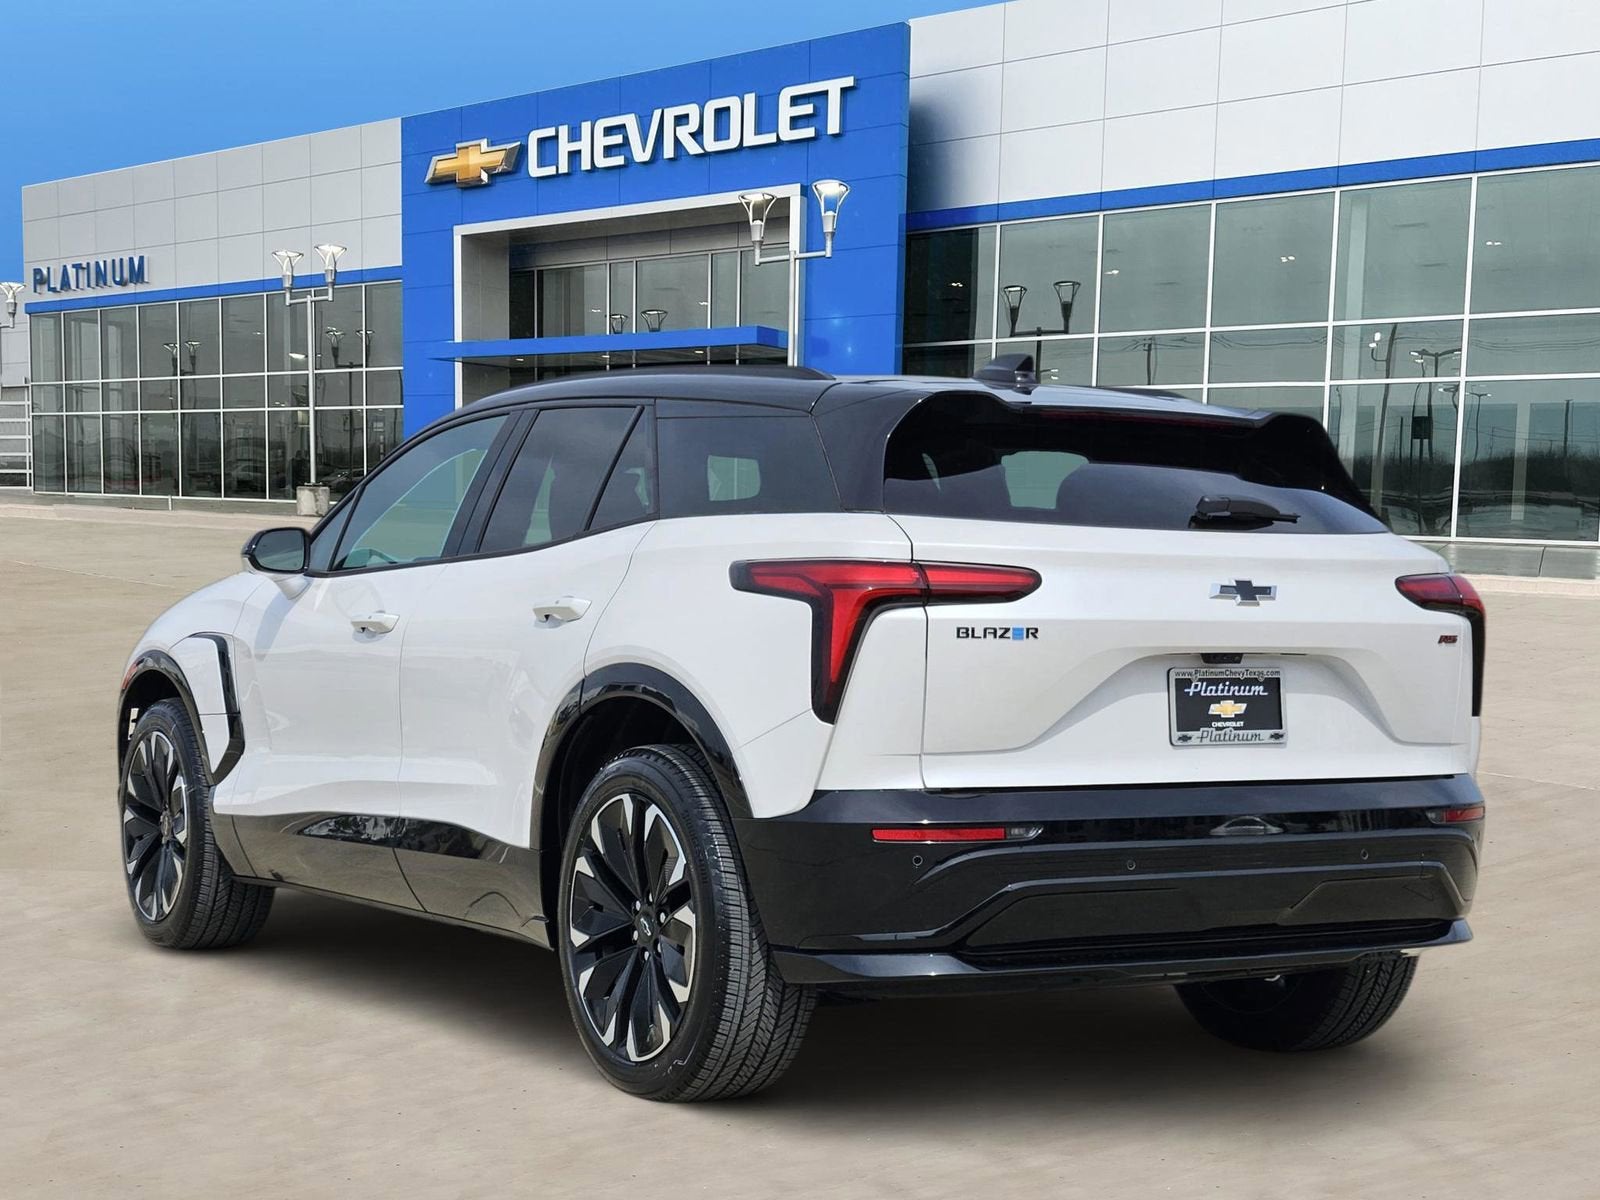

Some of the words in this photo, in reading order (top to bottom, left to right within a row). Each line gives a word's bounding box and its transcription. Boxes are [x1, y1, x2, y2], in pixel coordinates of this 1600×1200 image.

[527, 75, 855, 178] CHEVROLET
[33, 255, 146, 293] PLATINUM
[956, 626, 1039, 640] BLAZER
[1174, 669, 1280, 678] www.PlatinumChevyTexas.com
[1184, 681, 1269, 696] Platinum
[1197, 728, 1265, 743] Platinum
